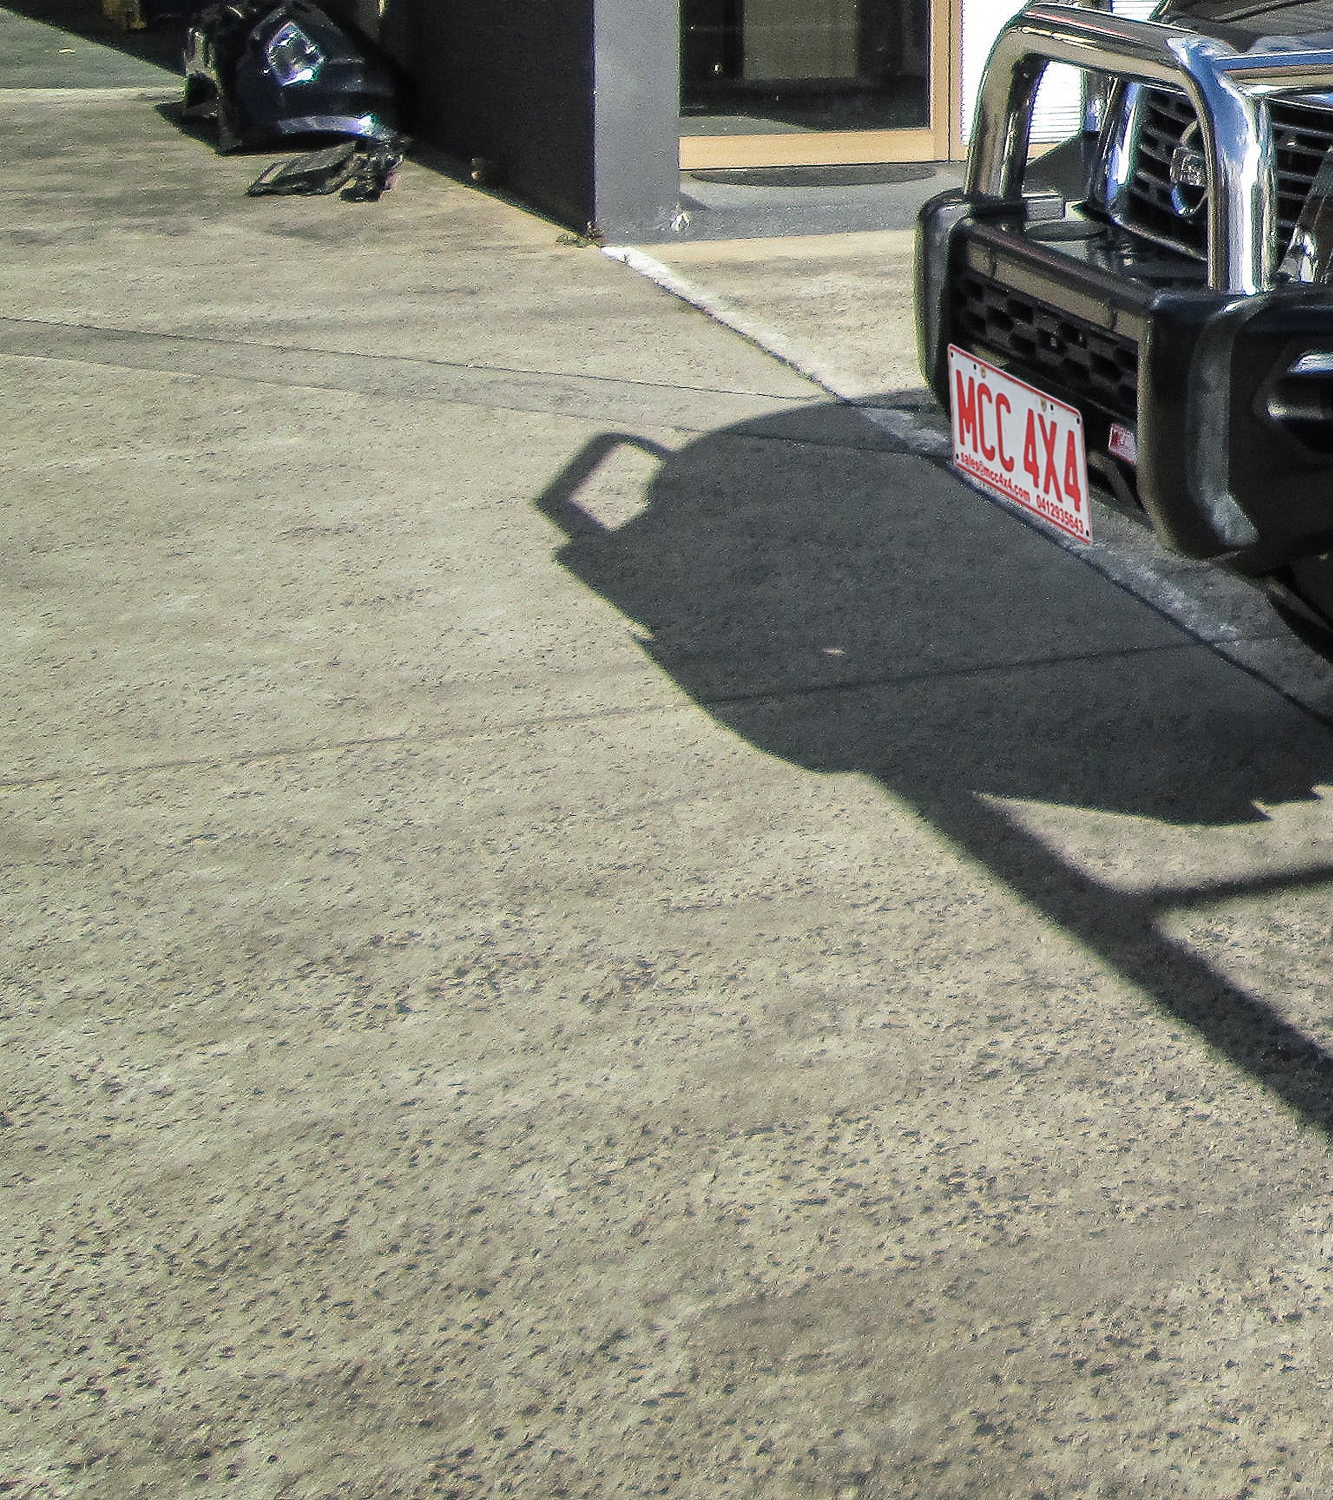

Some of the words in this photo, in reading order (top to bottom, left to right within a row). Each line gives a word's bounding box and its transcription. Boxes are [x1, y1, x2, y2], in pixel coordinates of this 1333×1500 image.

[956, 369, 1014, 472] MCC
[1023, 407, 1082, 513] 4X4
[960, 452, 1031, 503] sales@mcc4x4.com
